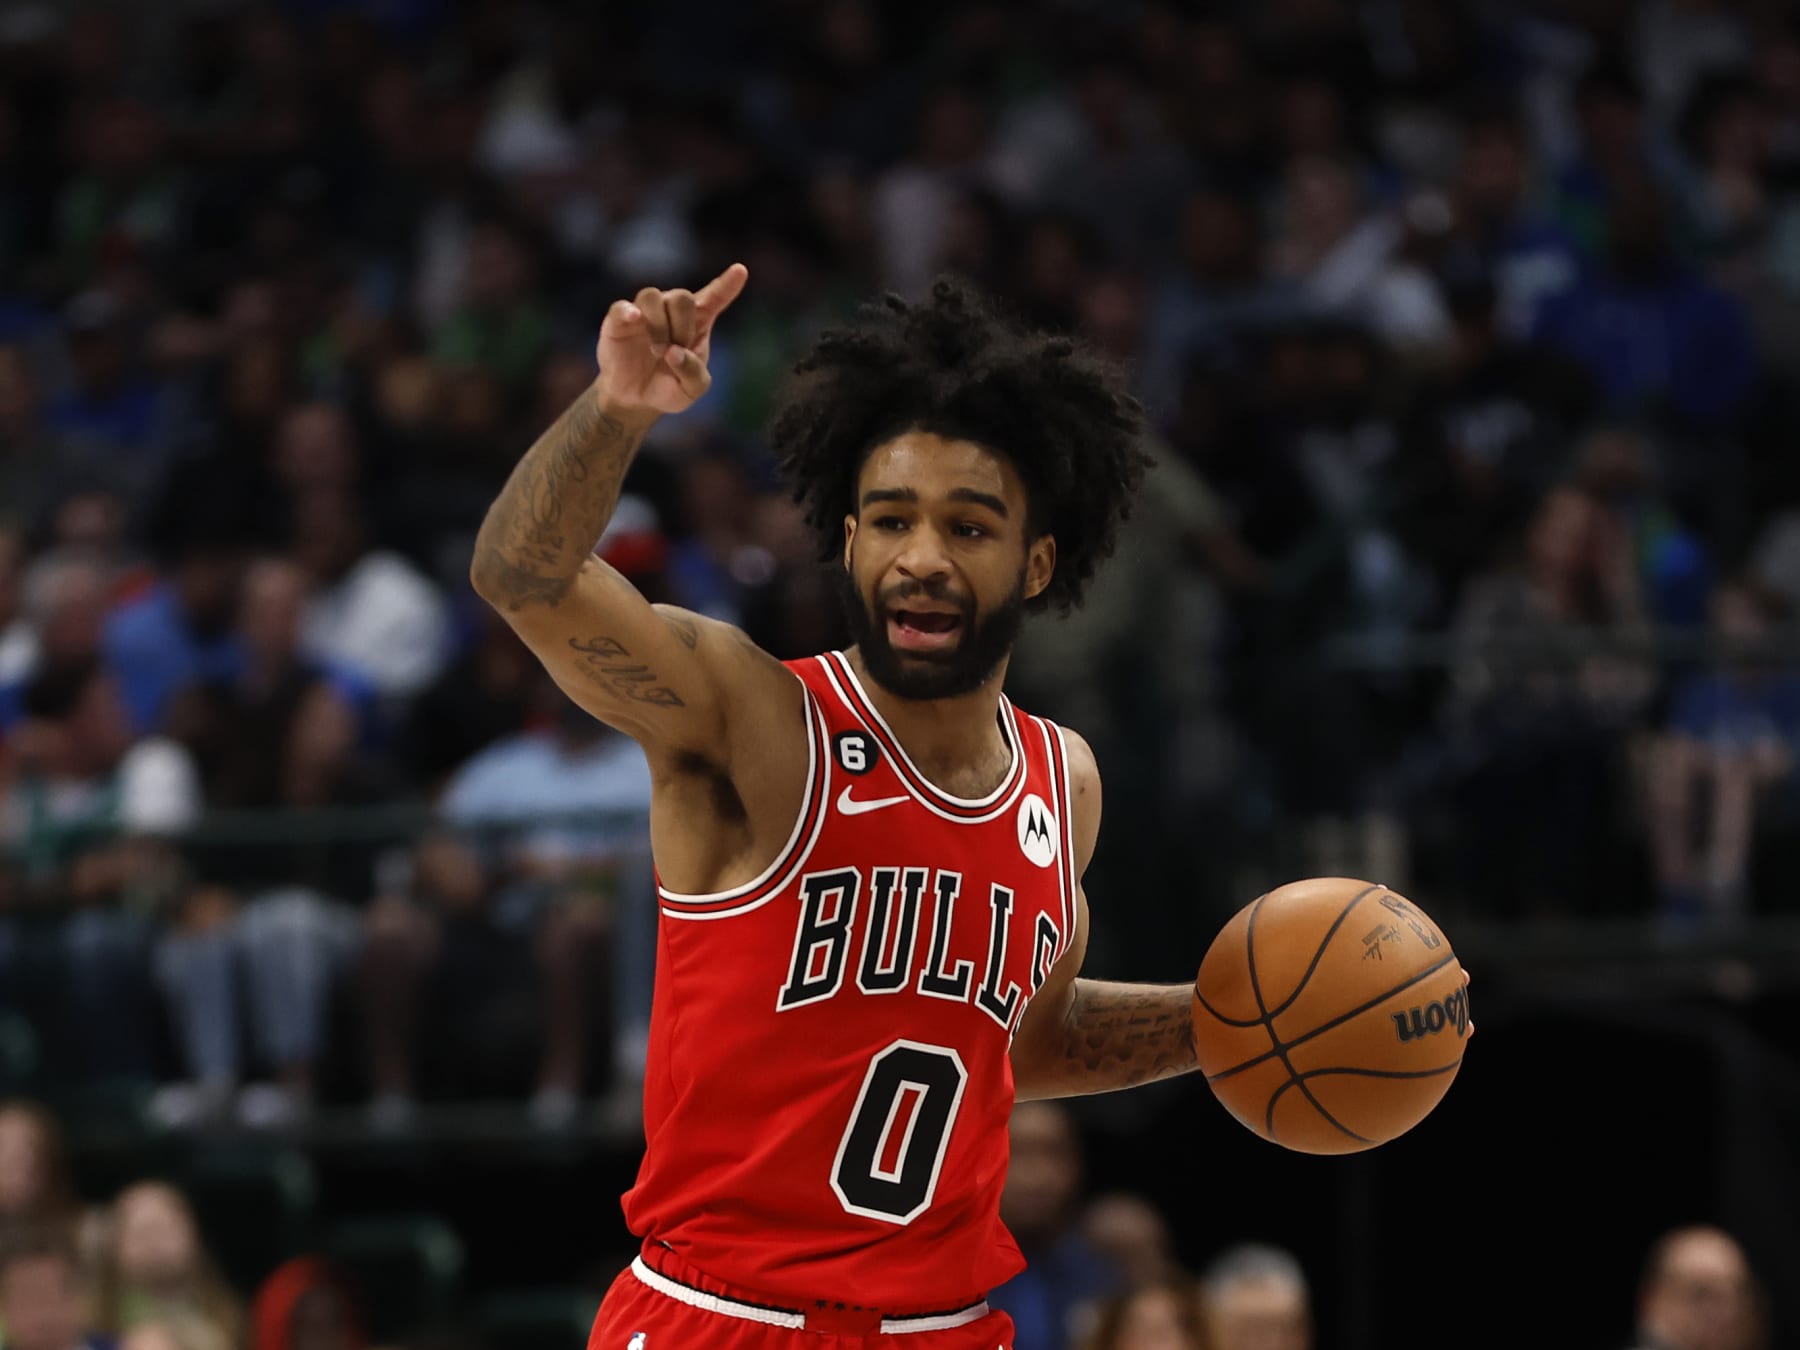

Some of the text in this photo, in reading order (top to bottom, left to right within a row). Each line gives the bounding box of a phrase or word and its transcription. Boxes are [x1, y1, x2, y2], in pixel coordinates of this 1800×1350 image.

[840, 736, 866, 771] 6
[1392, 985, 1469, 1043] lson
[830, 1038, 968, 1226] 0
